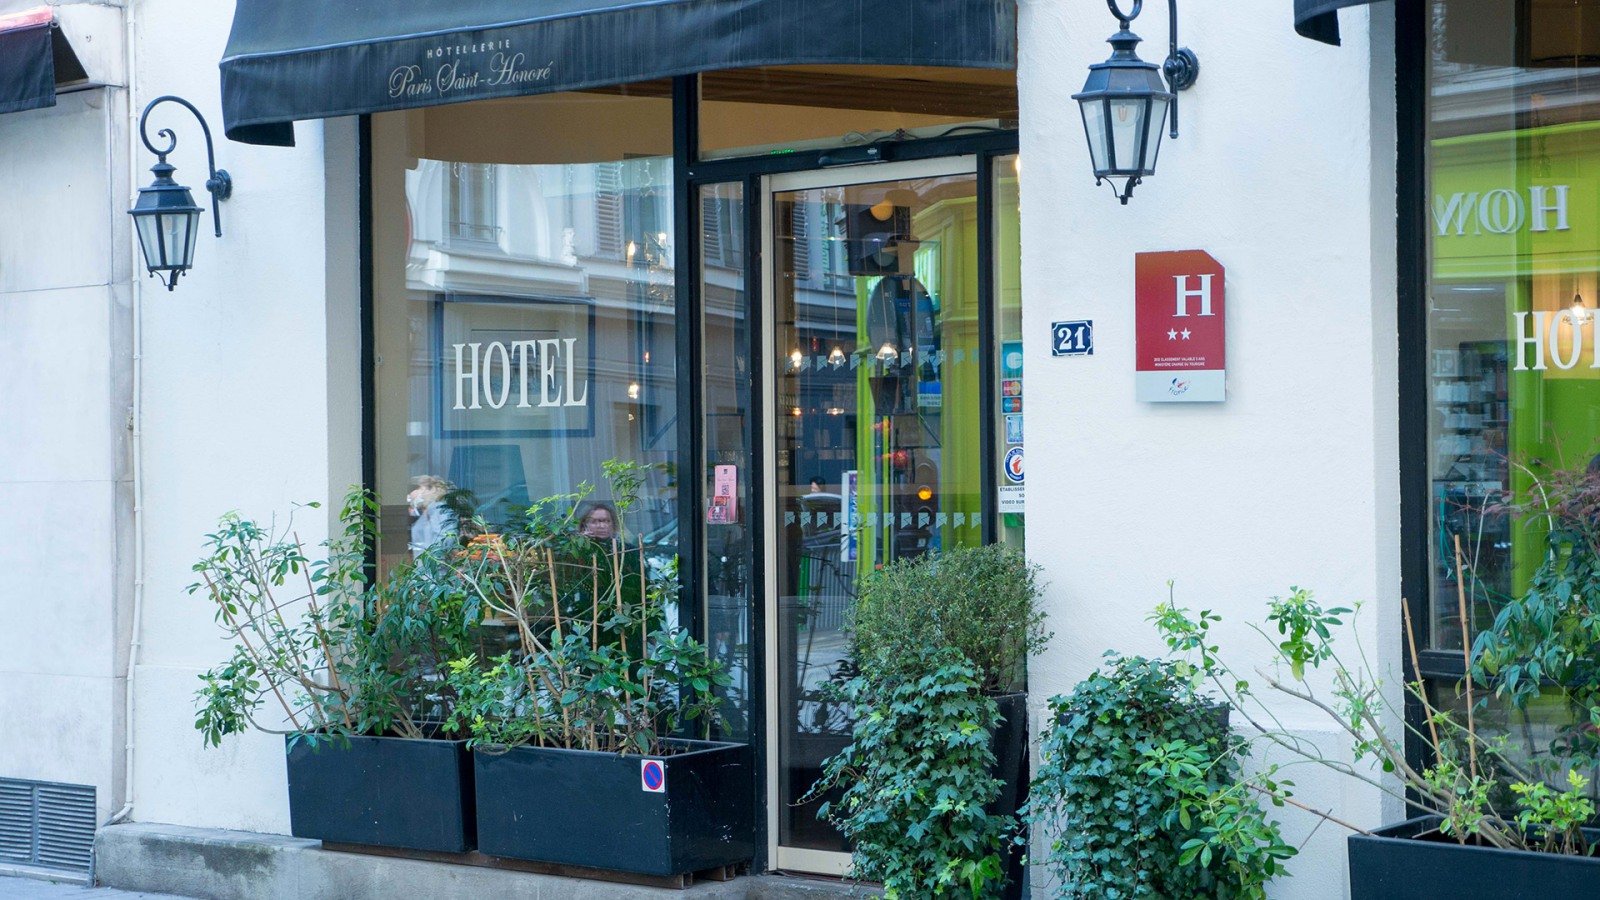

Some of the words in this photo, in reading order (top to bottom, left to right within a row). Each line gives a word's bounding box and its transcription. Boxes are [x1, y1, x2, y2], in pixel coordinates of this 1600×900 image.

[389, 65, 432, 98] Paris
[436, 52, 554, 95] Saint-Honoré
[1172, 274, 1216, 317] H
[1058, 326, 1085, 350] 21
[453, 338, 588, 410] HOTEL
